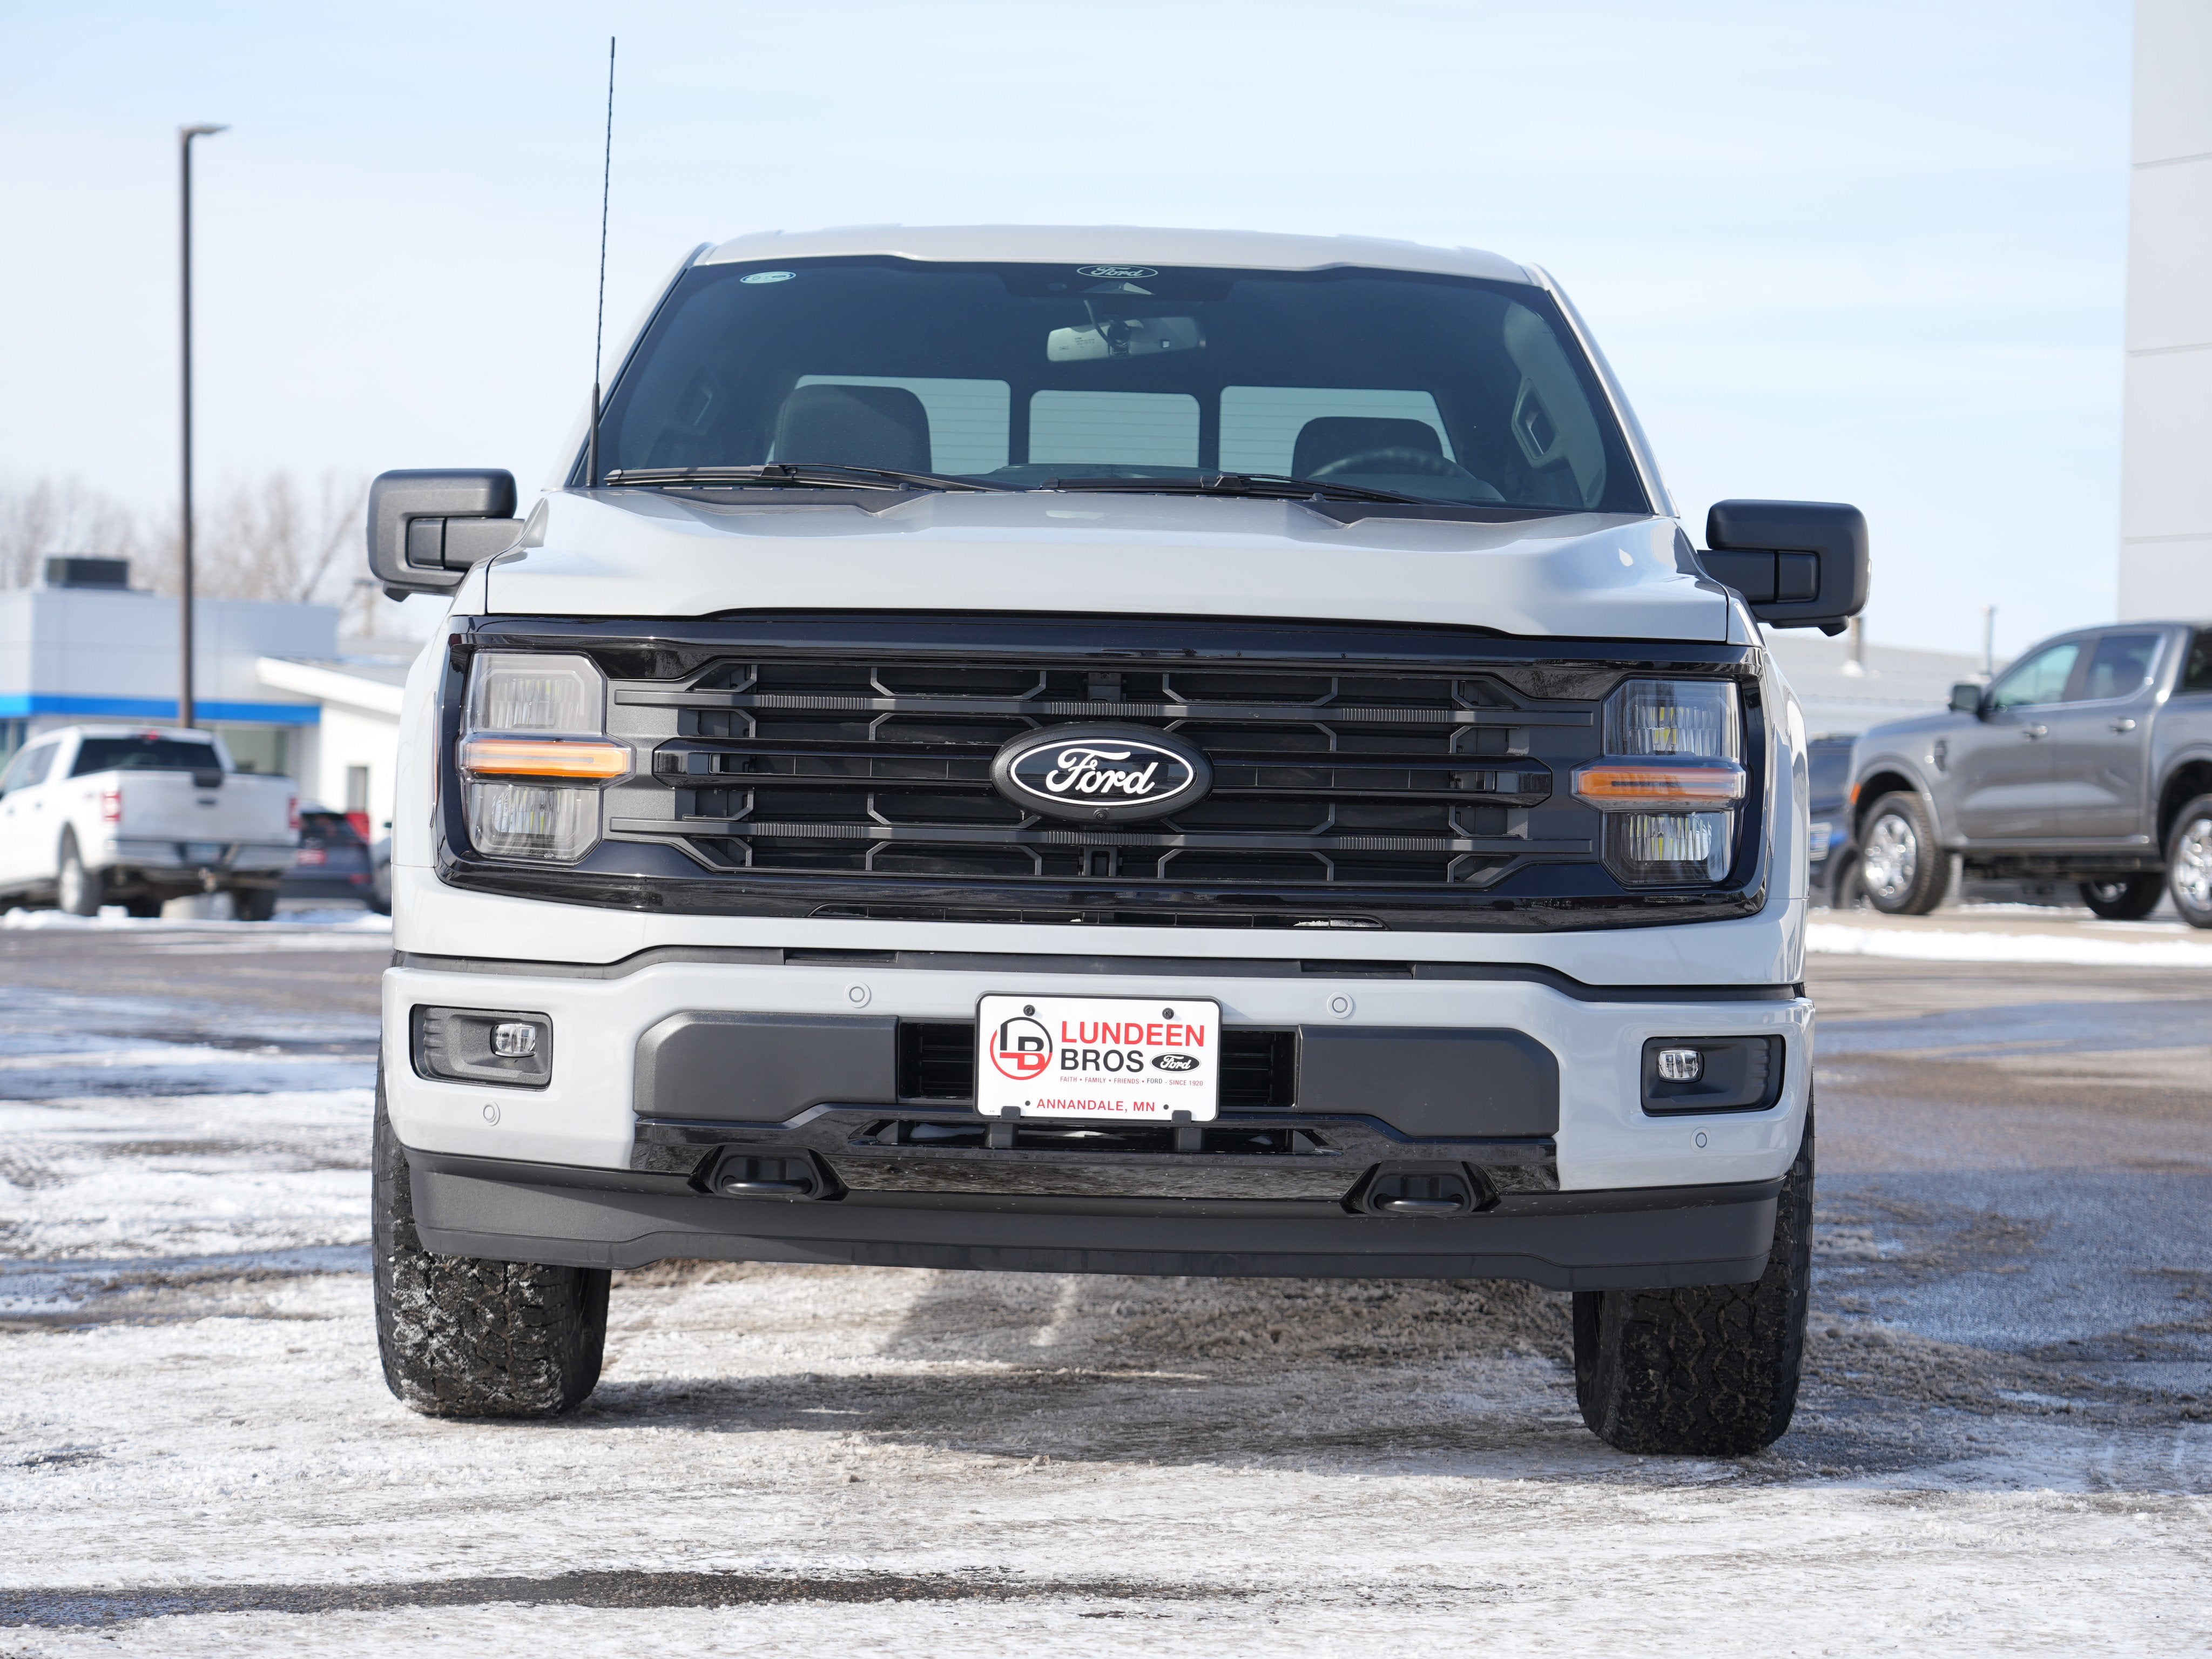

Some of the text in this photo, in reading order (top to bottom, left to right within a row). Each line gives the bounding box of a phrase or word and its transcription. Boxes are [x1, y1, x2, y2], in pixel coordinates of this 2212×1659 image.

[1090, 266, 1144, 276] Ford
[1046, 748, 1159, 794] Ford
[1061, 1021, 1205, 1047] LUNDEEN
[1061, 1048, 1144, 1073] BROS
[1159, 1055, 1192, 1070] Ford
[1036, 1098, 1155, 1112] ANNANDALE, MN
